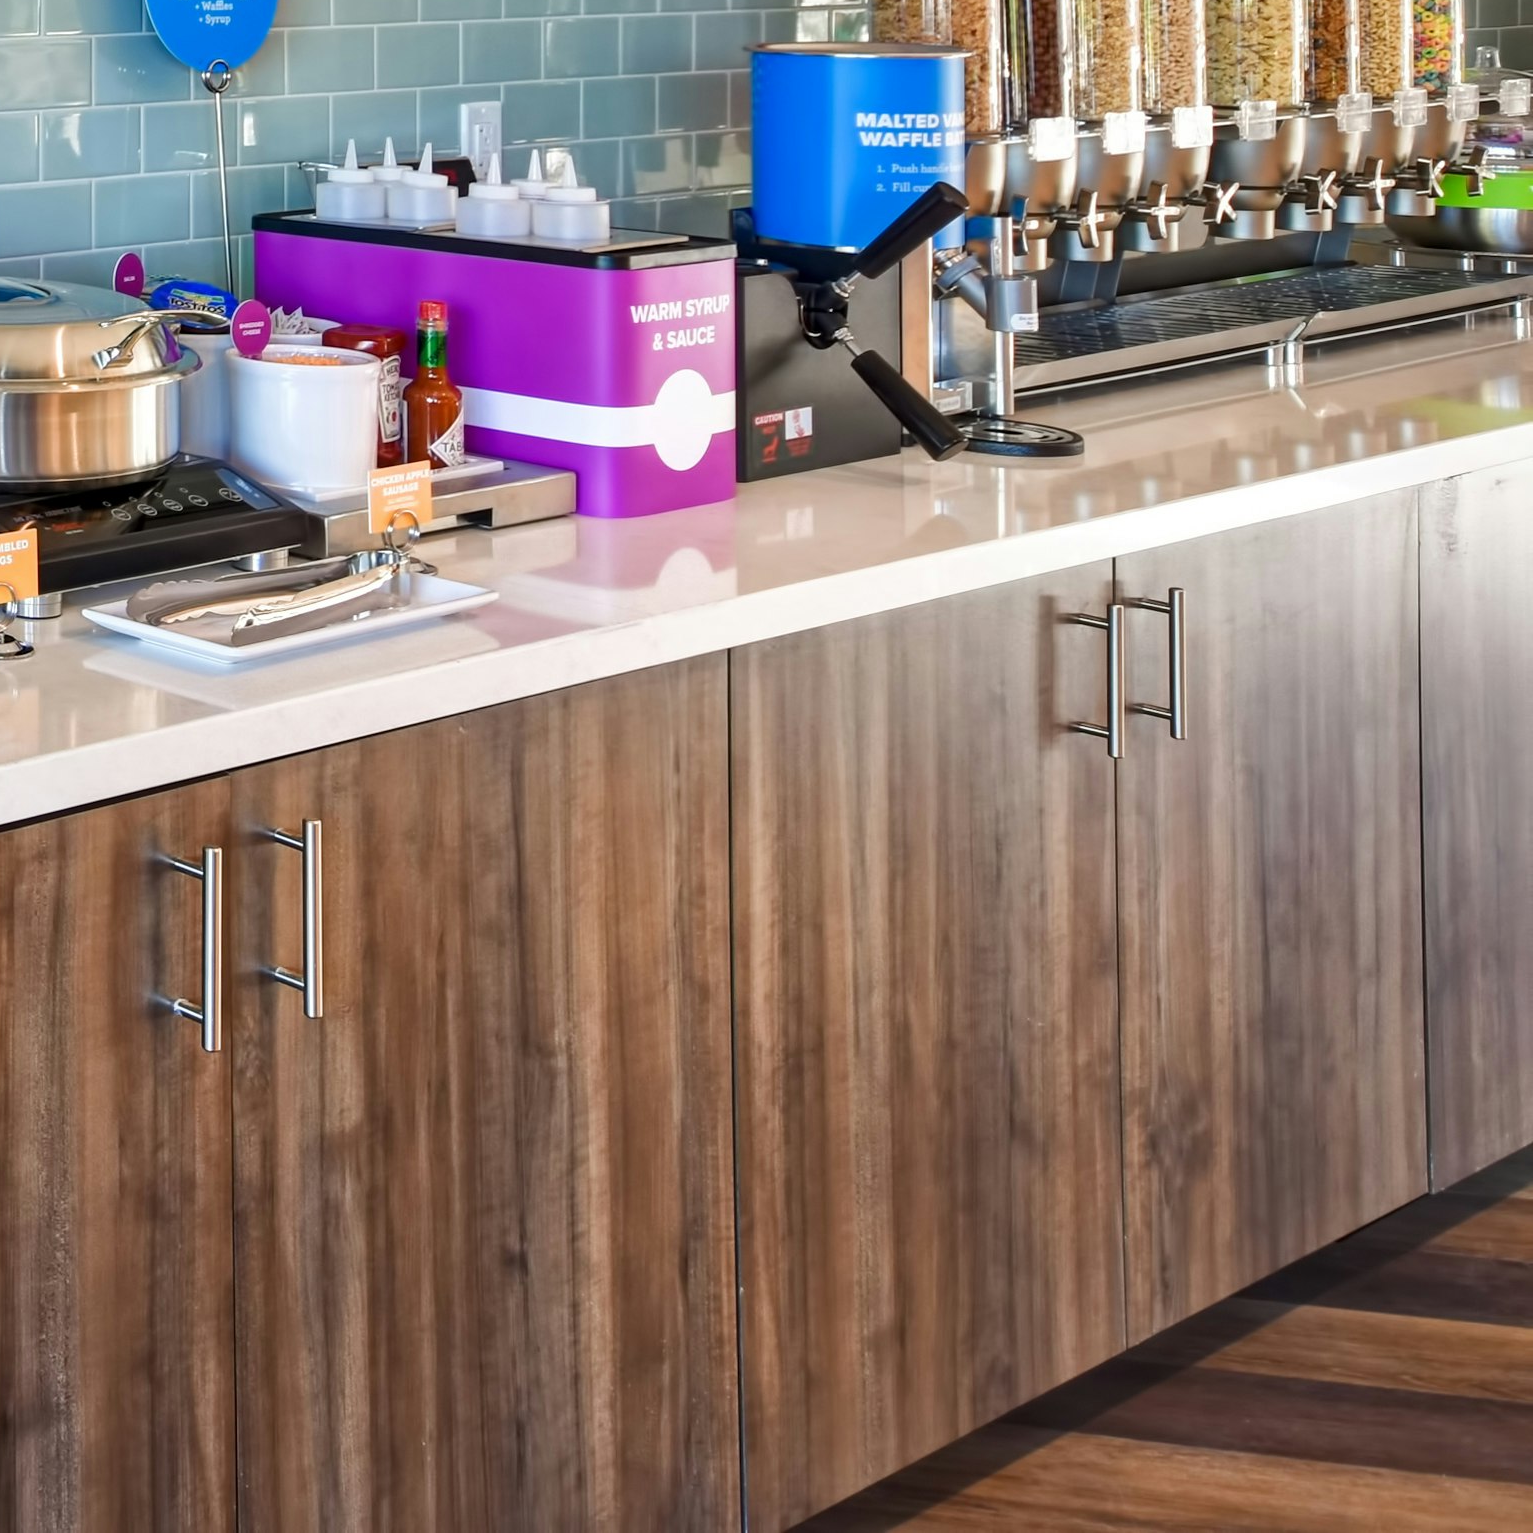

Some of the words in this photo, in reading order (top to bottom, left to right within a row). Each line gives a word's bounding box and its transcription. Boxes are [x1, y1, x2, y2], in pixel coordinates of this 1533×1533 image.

[202, 0, 233, 11] Waffles
[205, 14, 231, 26] Syrup
[856, 113, 939, 128] MALTED
[859, 131, 941, 147] WAFFLE
[877, 165, 885, 173] 1.
[891, 164, 918, 174] Push
[876, 184, 886, 192] 2.
[893, 182, 910, 192] Fill
[630, 301, 682, 323] WARM
[685, 294, 730, 317] SYRUP
[653, 333, 663, 351] &
[667, 326, 715, 348] SAUCE
[755, 412, 783, 425] CAUTION
